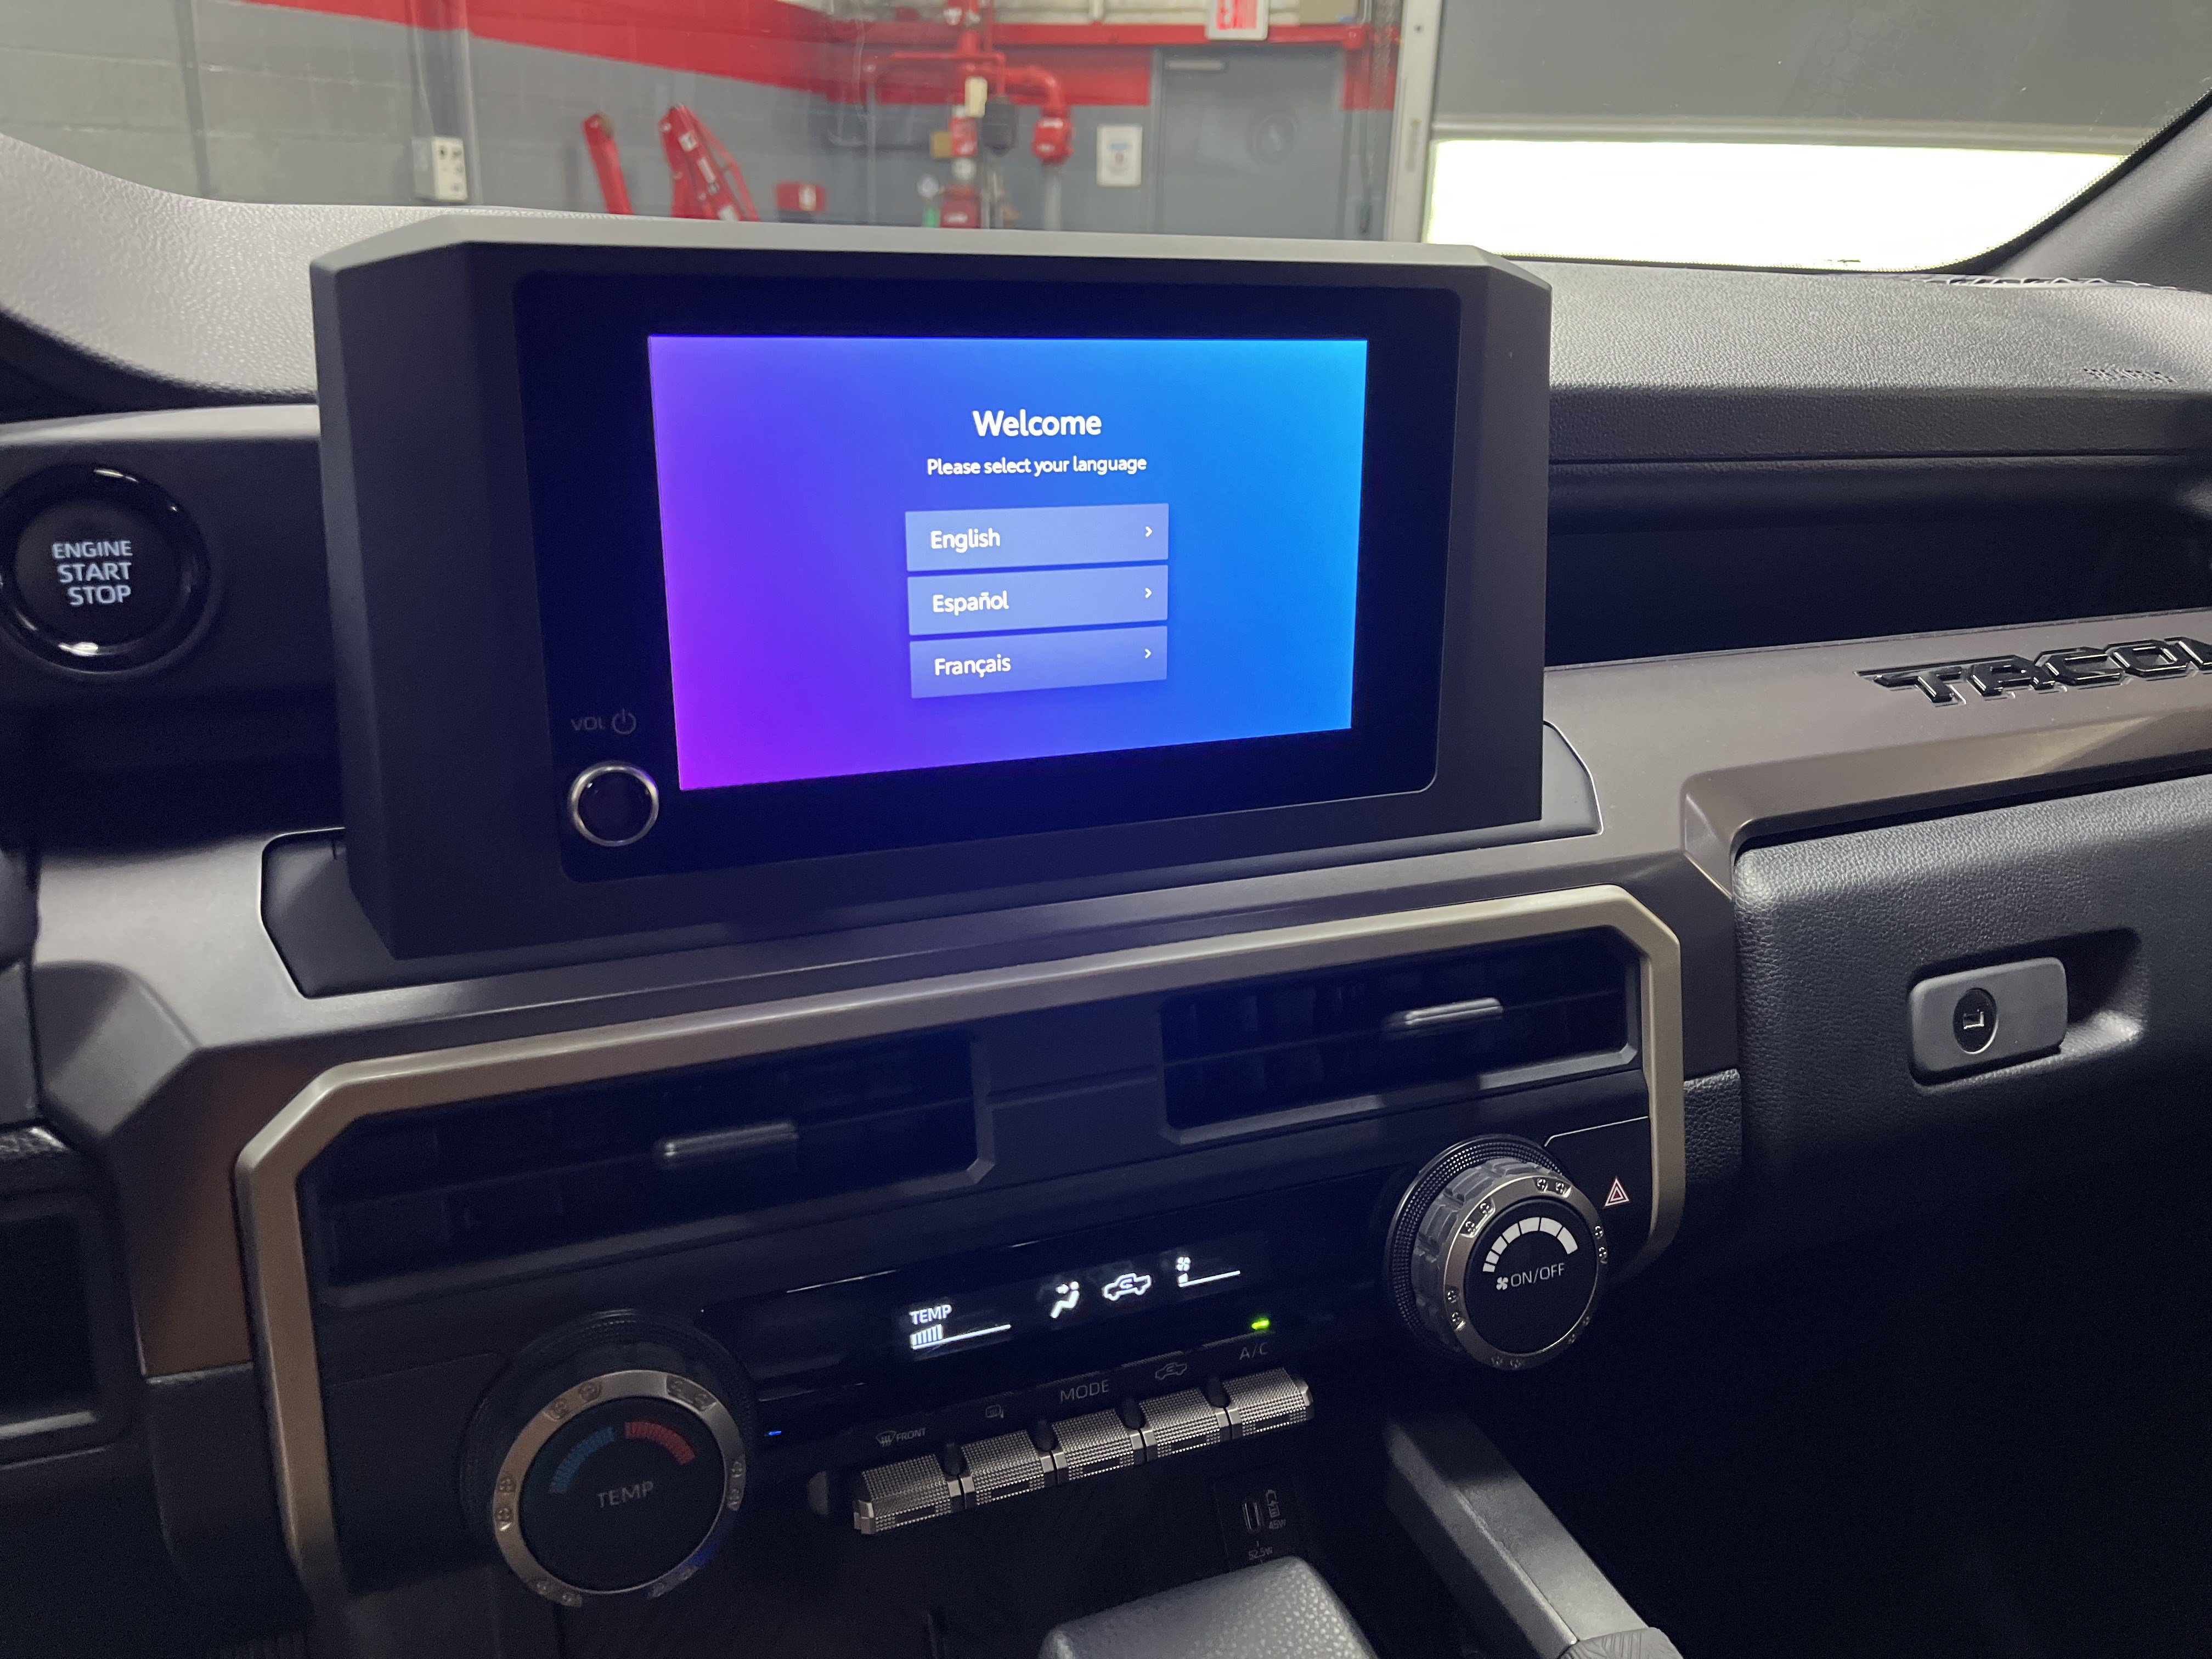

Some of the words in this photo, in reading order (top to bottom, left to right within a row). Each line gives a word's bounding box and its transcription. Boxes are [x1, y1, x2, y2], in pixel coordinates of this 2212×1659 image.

[972, 409, 1102, 437] Welcome
[927, 458, 981, 475] Please
[984, 457, 1031, 475] select
[1034, 459, 1069, 476] your
[1073, 456, 1147, 475] language
[51, 540, 133, 559] ENGINE
[930, 528, 1001, 554] English
[57, 562, 132, 583] START
[67, 585, 131, 606] STOP
[933, 590, 1009, 616] Español
[934, 654, 1011, 678] Français
[571, 715, 605, 731] VOL
[1510, 1262, 1565, 1288] ON/OFF
[910, 1304, 952, 1325] TEMP
[1239, 1342, 1268, 1361] A/C
[1059, 1379, 1110, 1403] MODE
[896, 1427, 926, 1442] FRONT
[597, 1480, 654, 1509] TEMP
